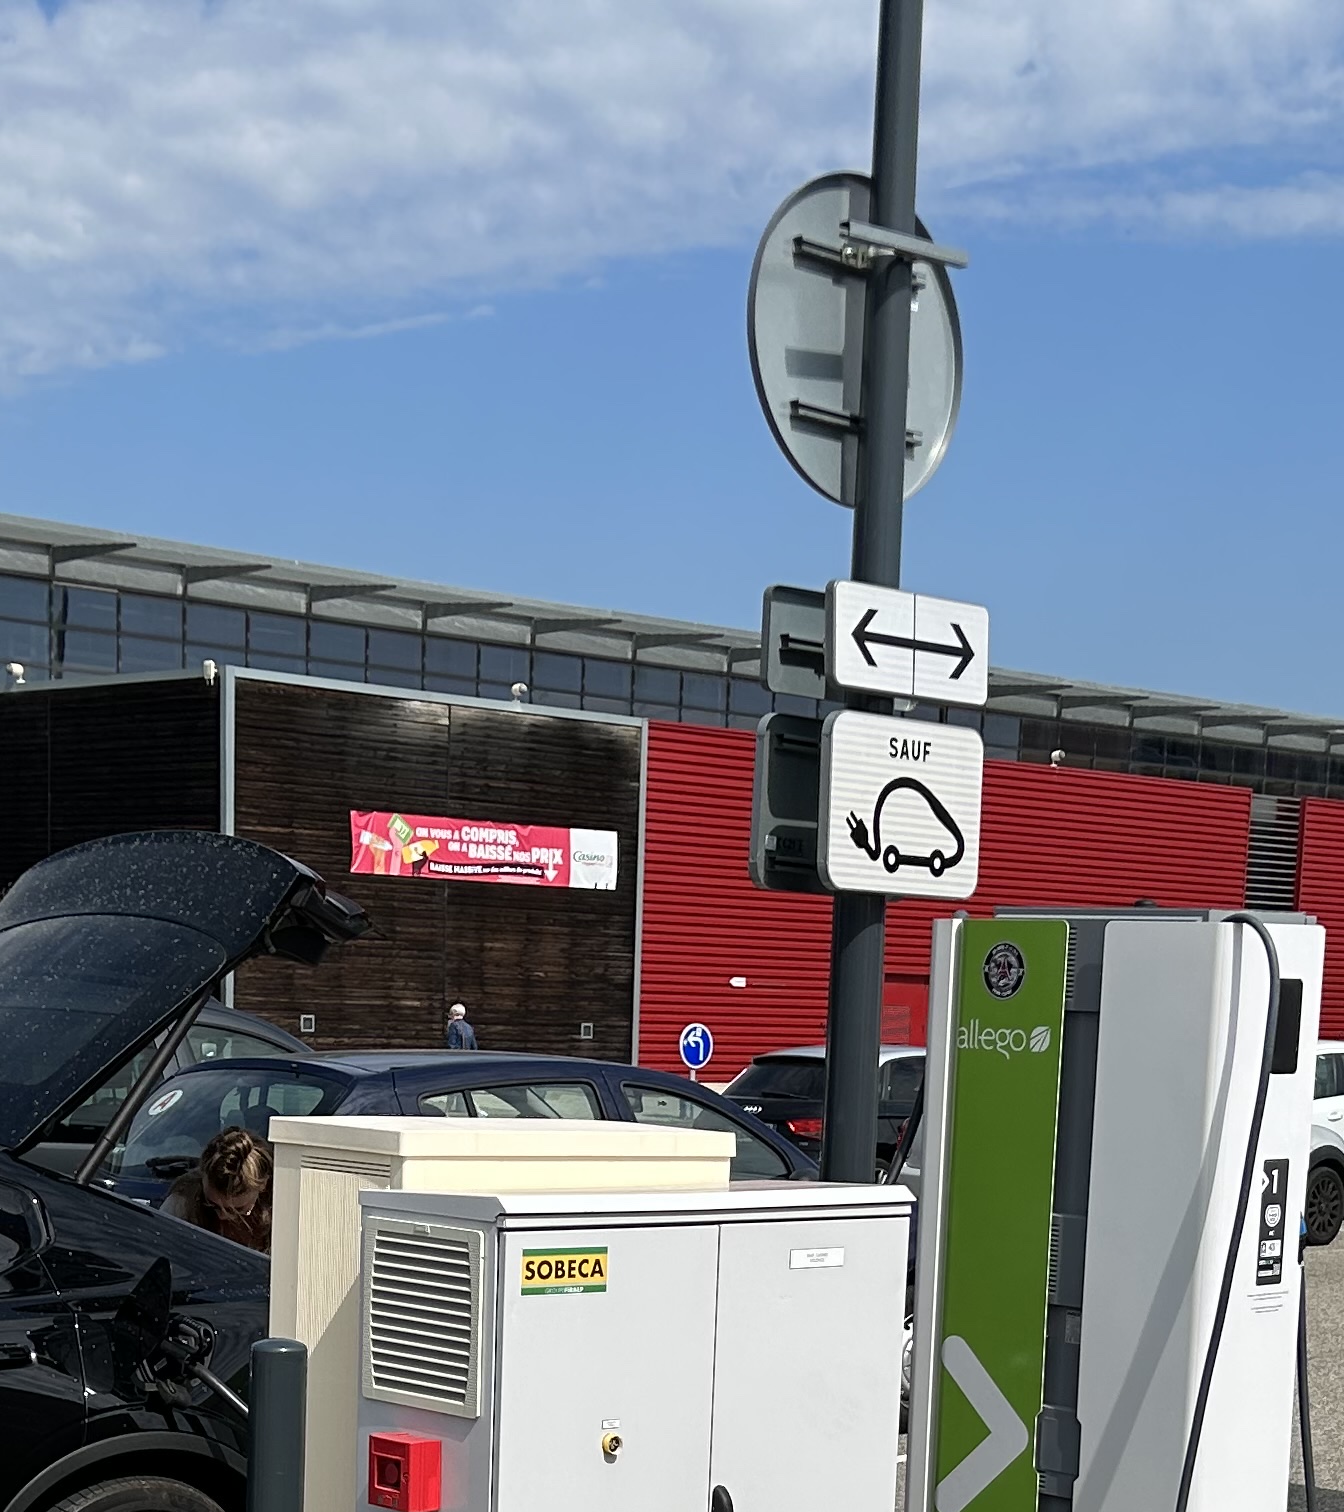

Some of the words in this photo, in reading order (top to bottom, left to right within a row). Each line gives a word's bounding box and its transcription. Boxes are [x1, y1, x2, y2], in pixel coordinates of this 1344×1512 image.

[889, 737, 932, 762] SAUF
[430, 828, 452, 839] VOUS
[453, 830, 460, 840] A
[461, 826, 519, 847] COMPRIS,
[461, 842, 468, 852] A
[468, 842, 512, 861] BAISSÉ
[531, 847, 563, 865] PRIX
[573, 851, 605, 863] Casino
[958, 1019, 1027, 1060] allego
[1271, 1169, 1279, 1194] 1
[524, 1259, 604, 1281] SOBECA
